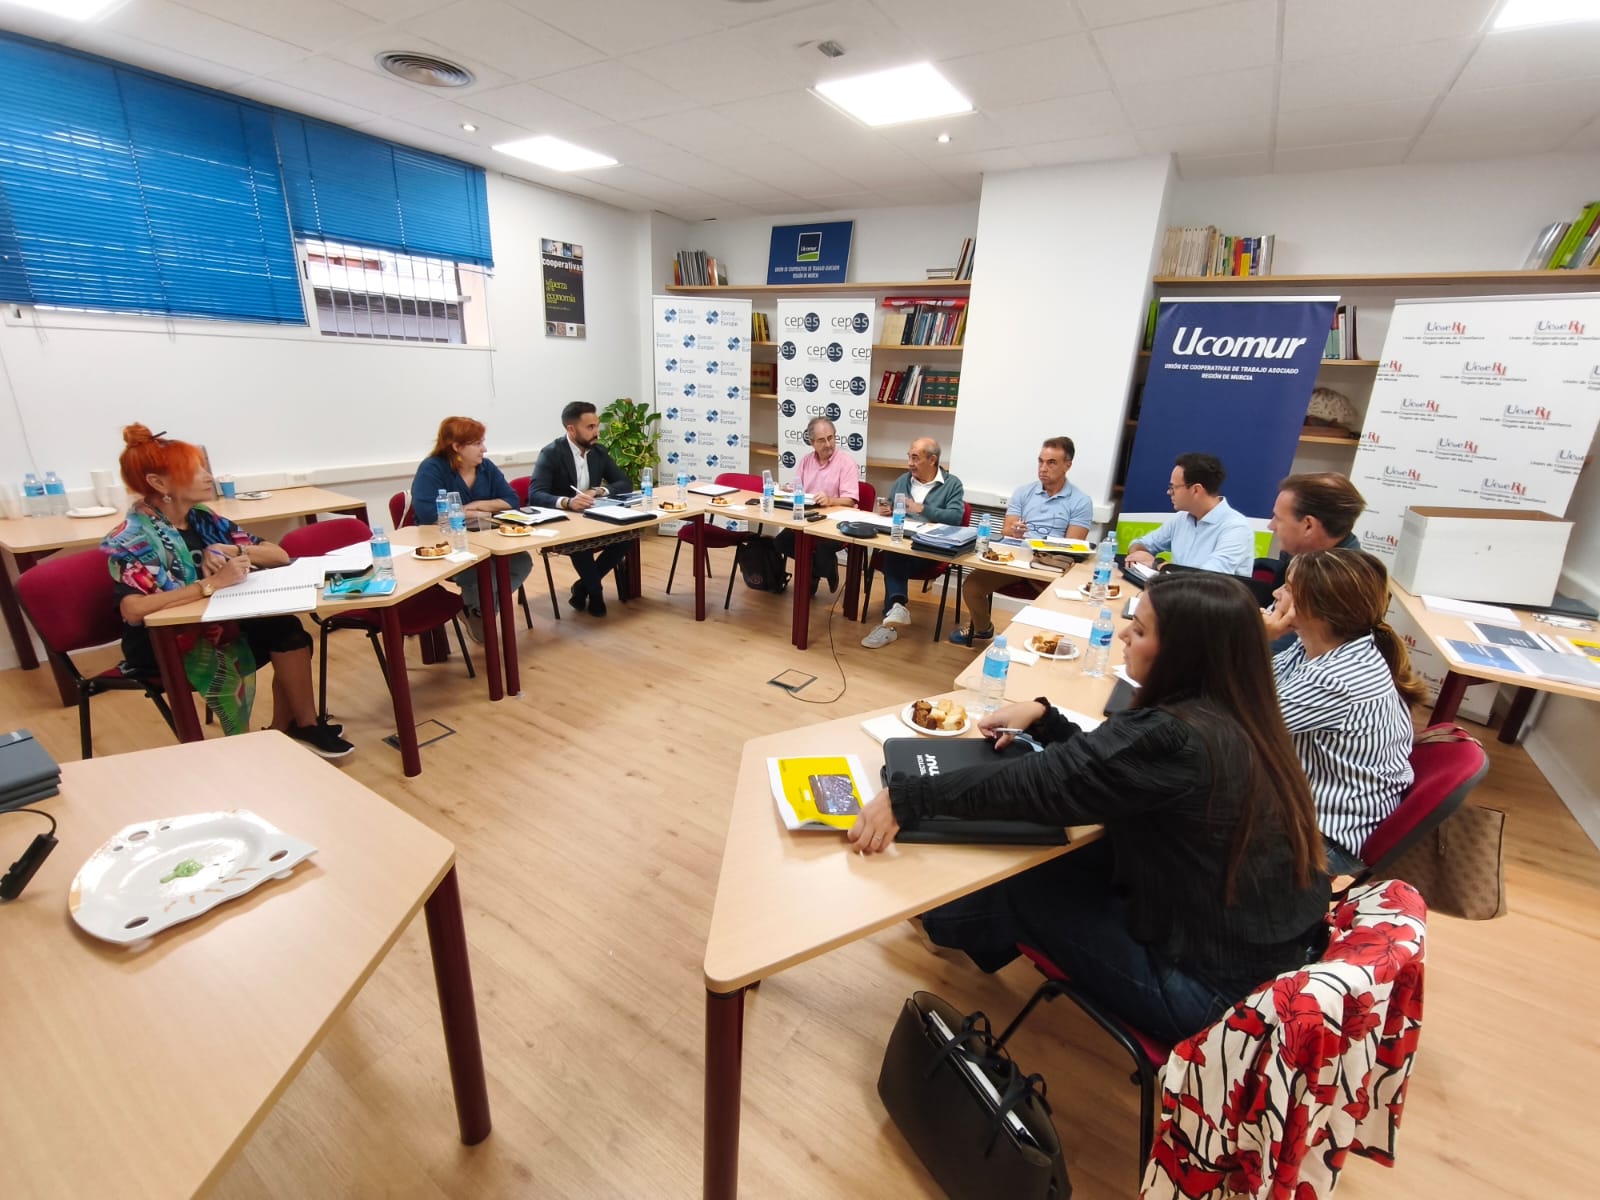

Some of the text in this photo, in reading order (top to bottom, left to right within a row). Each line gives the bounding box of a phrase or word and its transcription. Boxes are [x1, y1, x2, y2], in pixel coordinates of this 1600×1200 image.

[785, 316, 819, 329] cepes
[832, 316, 868, 330] cepes
[1172, 327, 1307, 359] Ucomur
[807, 345, 842, 359] cepes
[785, 376, 818, 388] cepes
[830, 379, 865, 392] cepes
[806, 405, 840, 417] cepes
[785, 429, 809, 441] cepe
[835, 435, 863, 447] epes
[925, 754, 940, 776] mur
